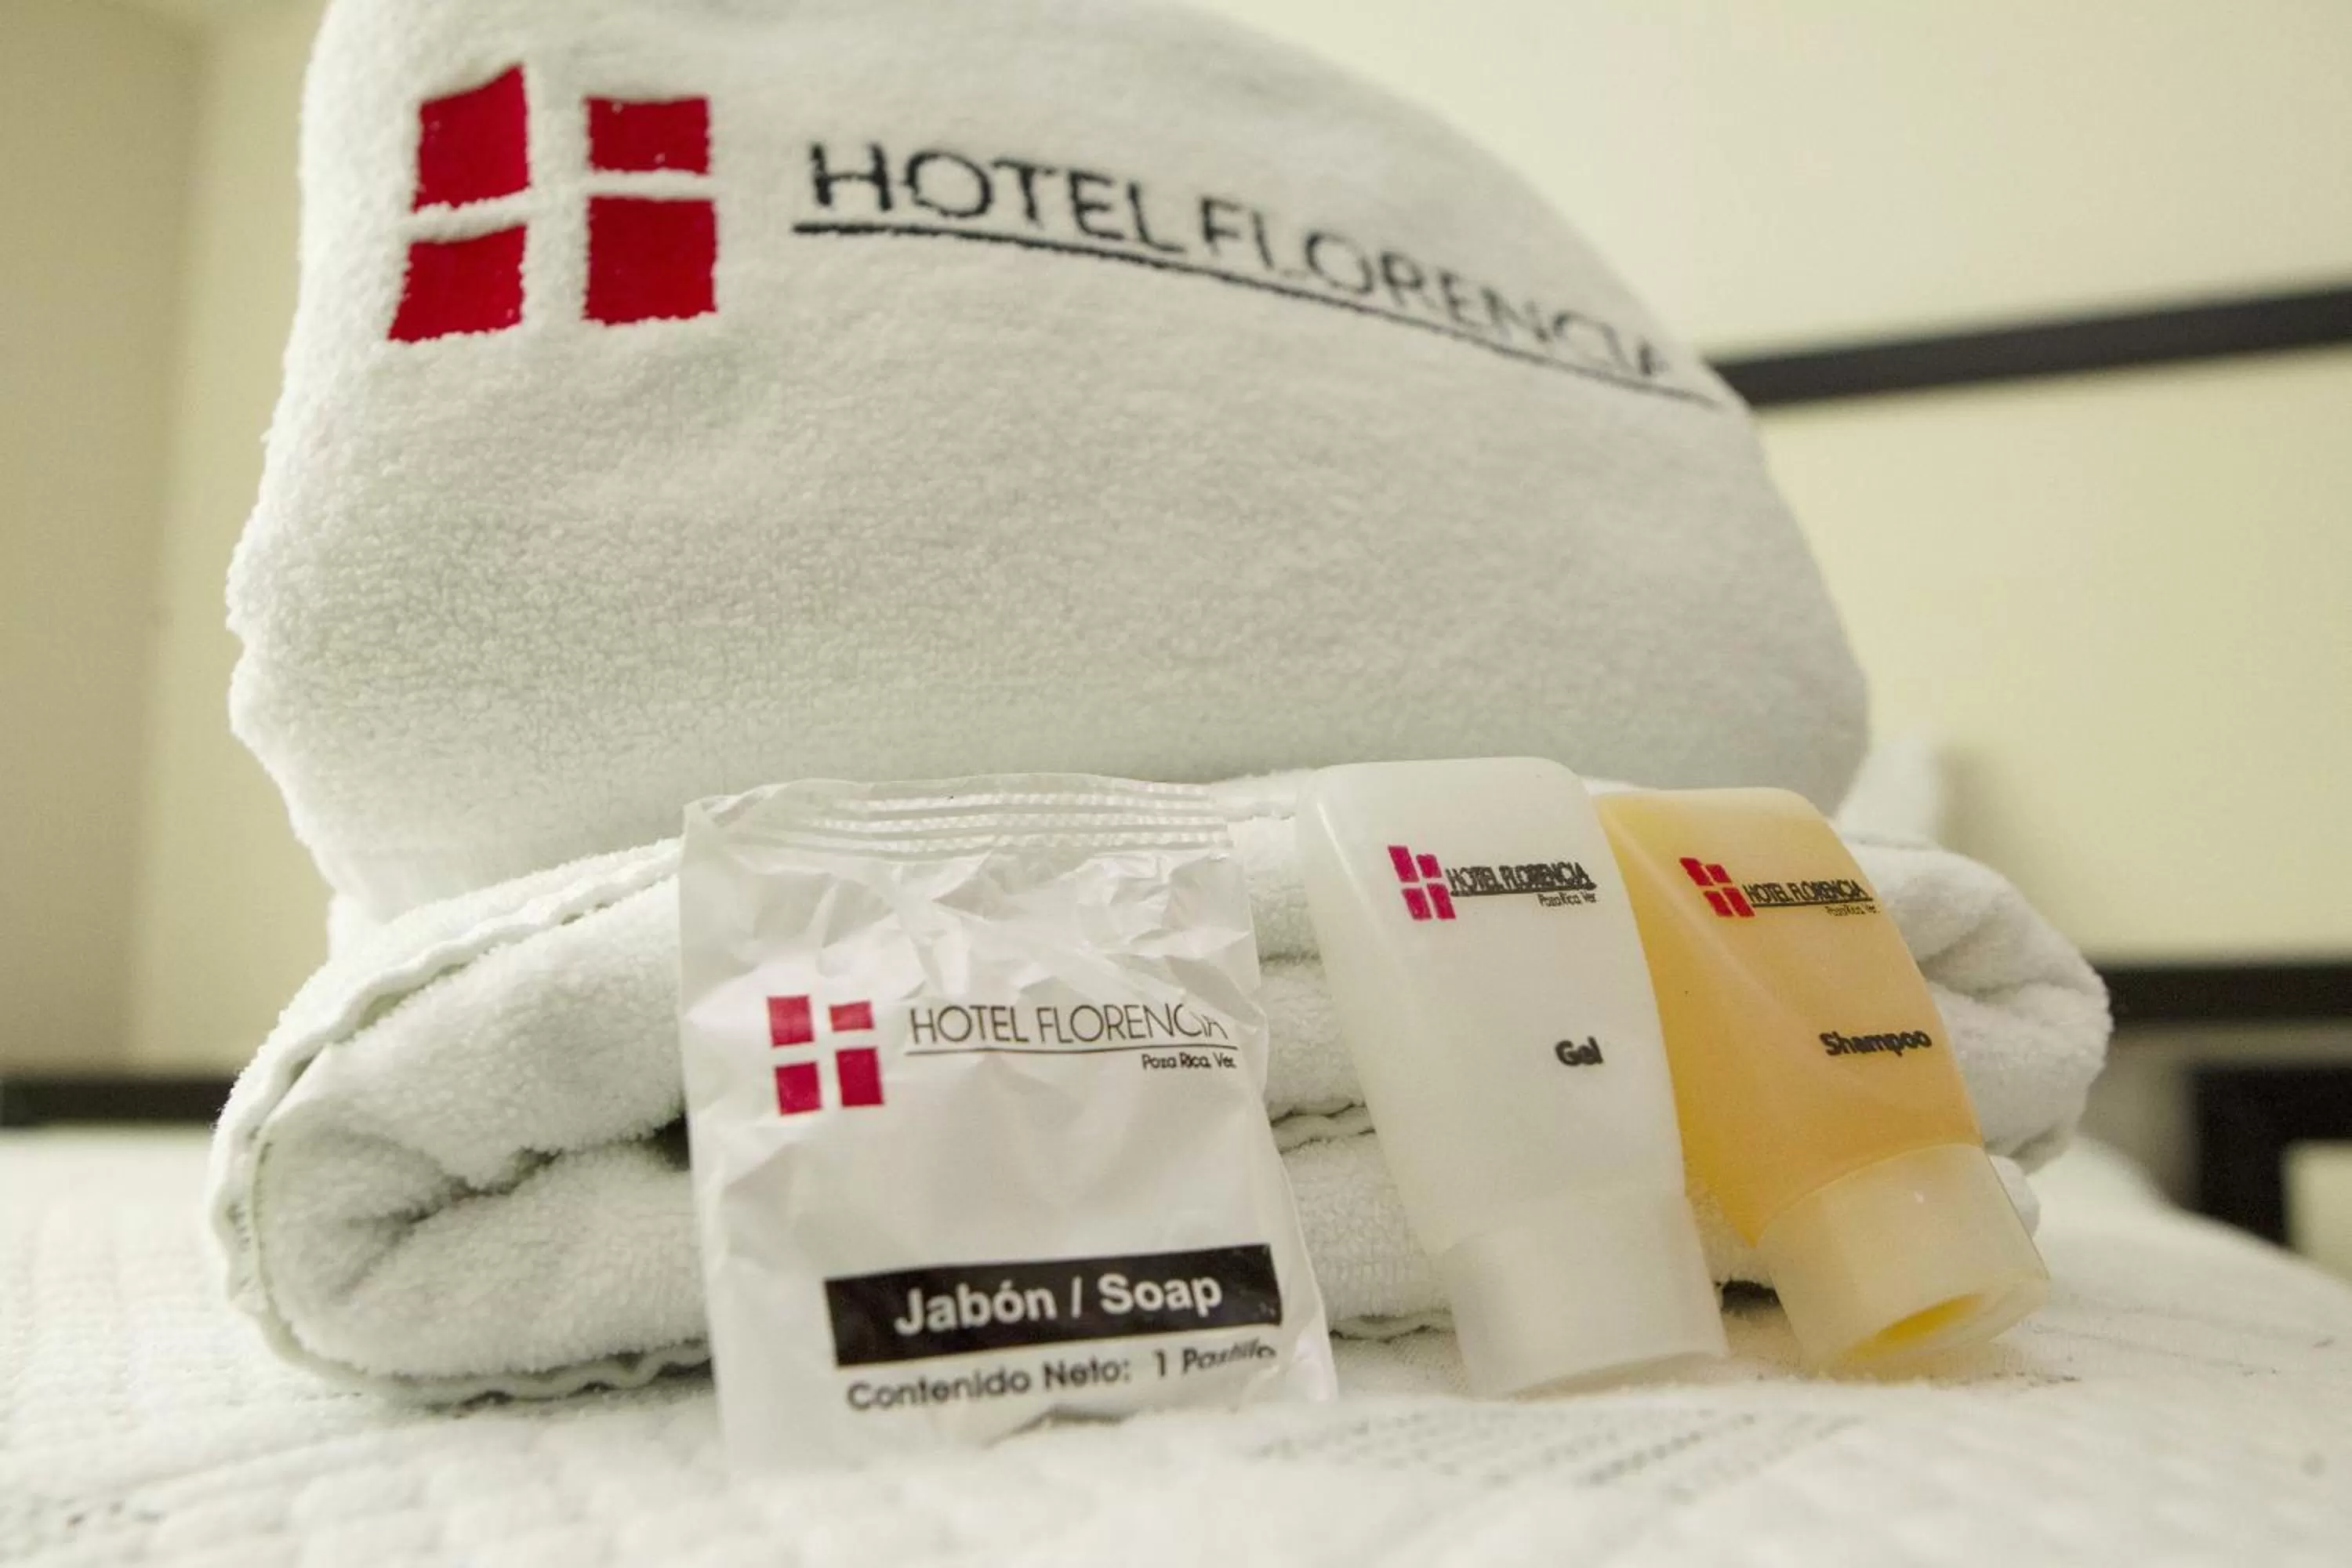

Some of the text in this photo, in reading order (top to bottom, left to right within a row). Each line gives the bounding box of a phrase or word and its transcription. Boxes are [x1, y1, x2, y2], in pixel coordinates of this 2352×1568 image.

[808, 143, 1188, 255] HOTEL
[1445, 866, 1503, 892] HOTEL
[1741, 882, 1794, 903] HOTEL
[909, 1004, 1029, 1044] HOTEL
[1554, 1035, 1604, 1066] Gel
[1819, 1029, 1933, 1058] Shampoo
[1142, 1053, 1177, 1069] Poza
[894, 1278, 1057, 1337] Jabón
[1098, 1272, 1222, 1317] Soap
[847, 1366, 1032, 1412] Contenido
[1044, 1358, 1131, 1392] Neto:
[1154, 1347, 1167, 1377] 1
